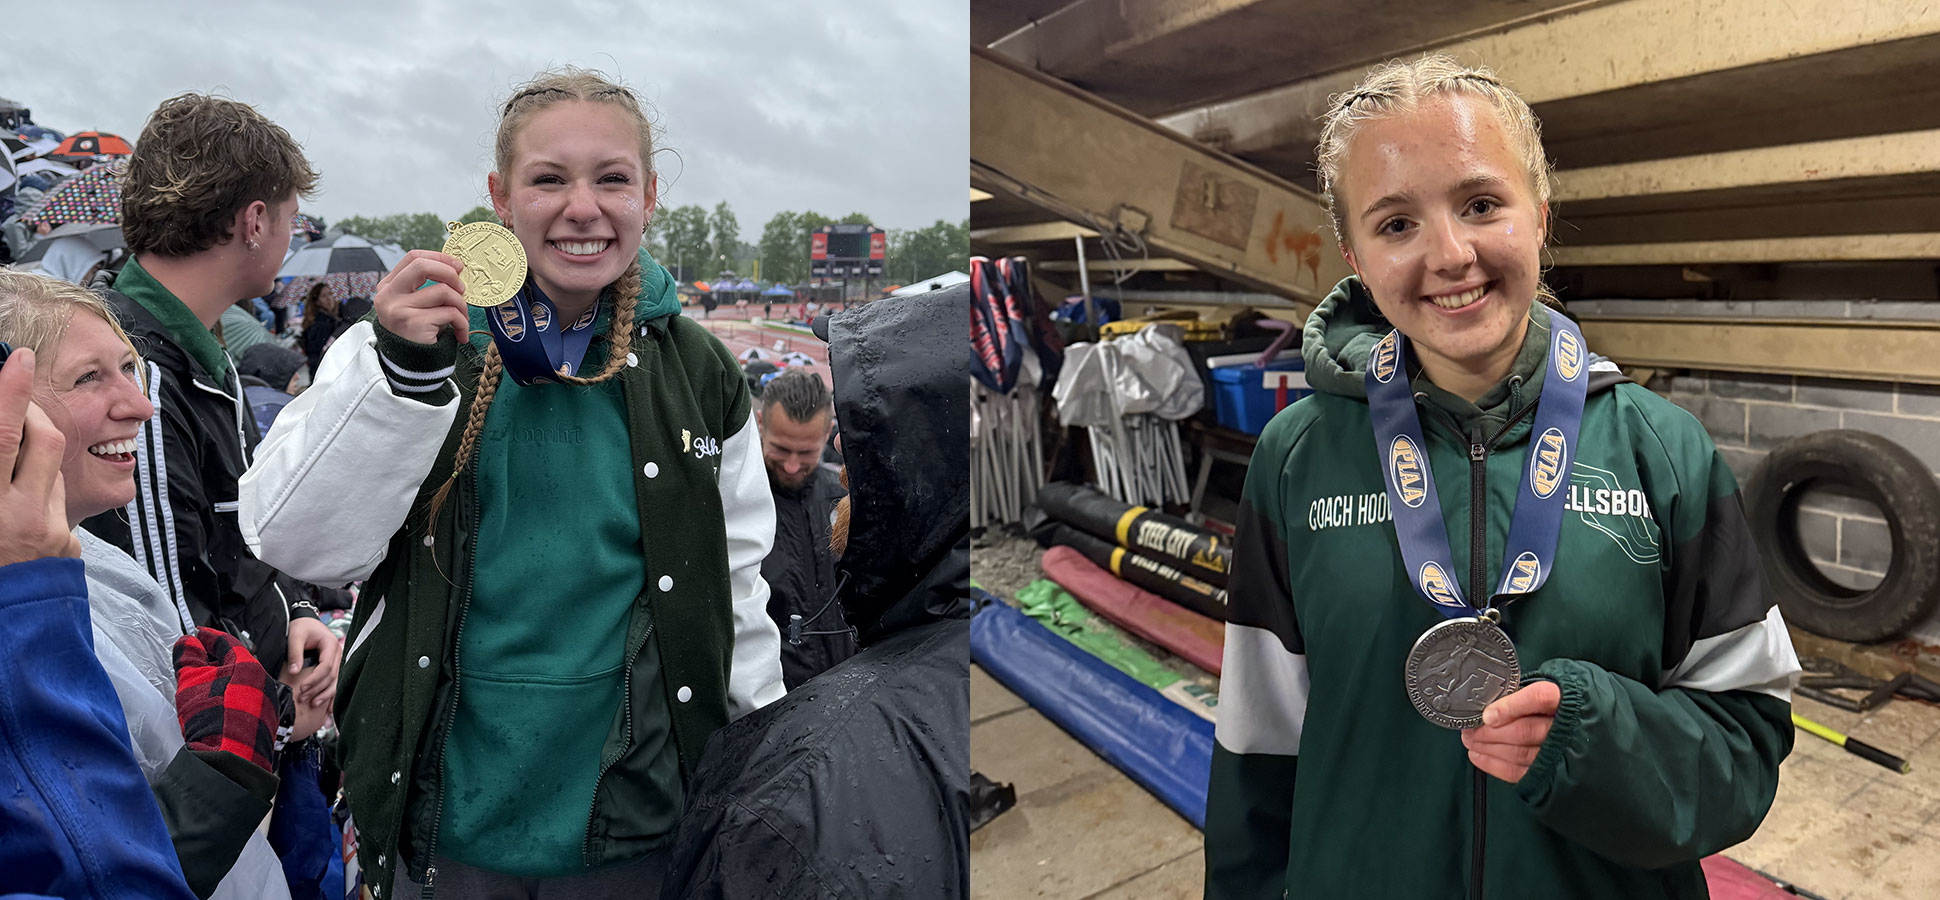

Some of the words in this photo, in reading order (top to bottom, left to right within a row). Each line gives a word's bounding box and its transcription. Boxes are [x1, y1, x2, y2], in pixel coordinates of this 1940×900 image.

[443, 223, 477, 254] CHOLASTIC
[1376, 332, 1395, 379] PIAA
[1559, 331, 1580, 379] PIAA
[1393, 439, 1425, 503] PIAA
[1535, 434, 1563, 495] PIAA
[1308, 495, 1353, 531] COACH
[1137, 520, 1170, 552] STEEL
[1166, 529, 1199, 559] CITY
[1418, 622, 1508, 651] INTERSCHOLASTIC
[1407, 650, 1436, 719] PENNSYLVANIA
